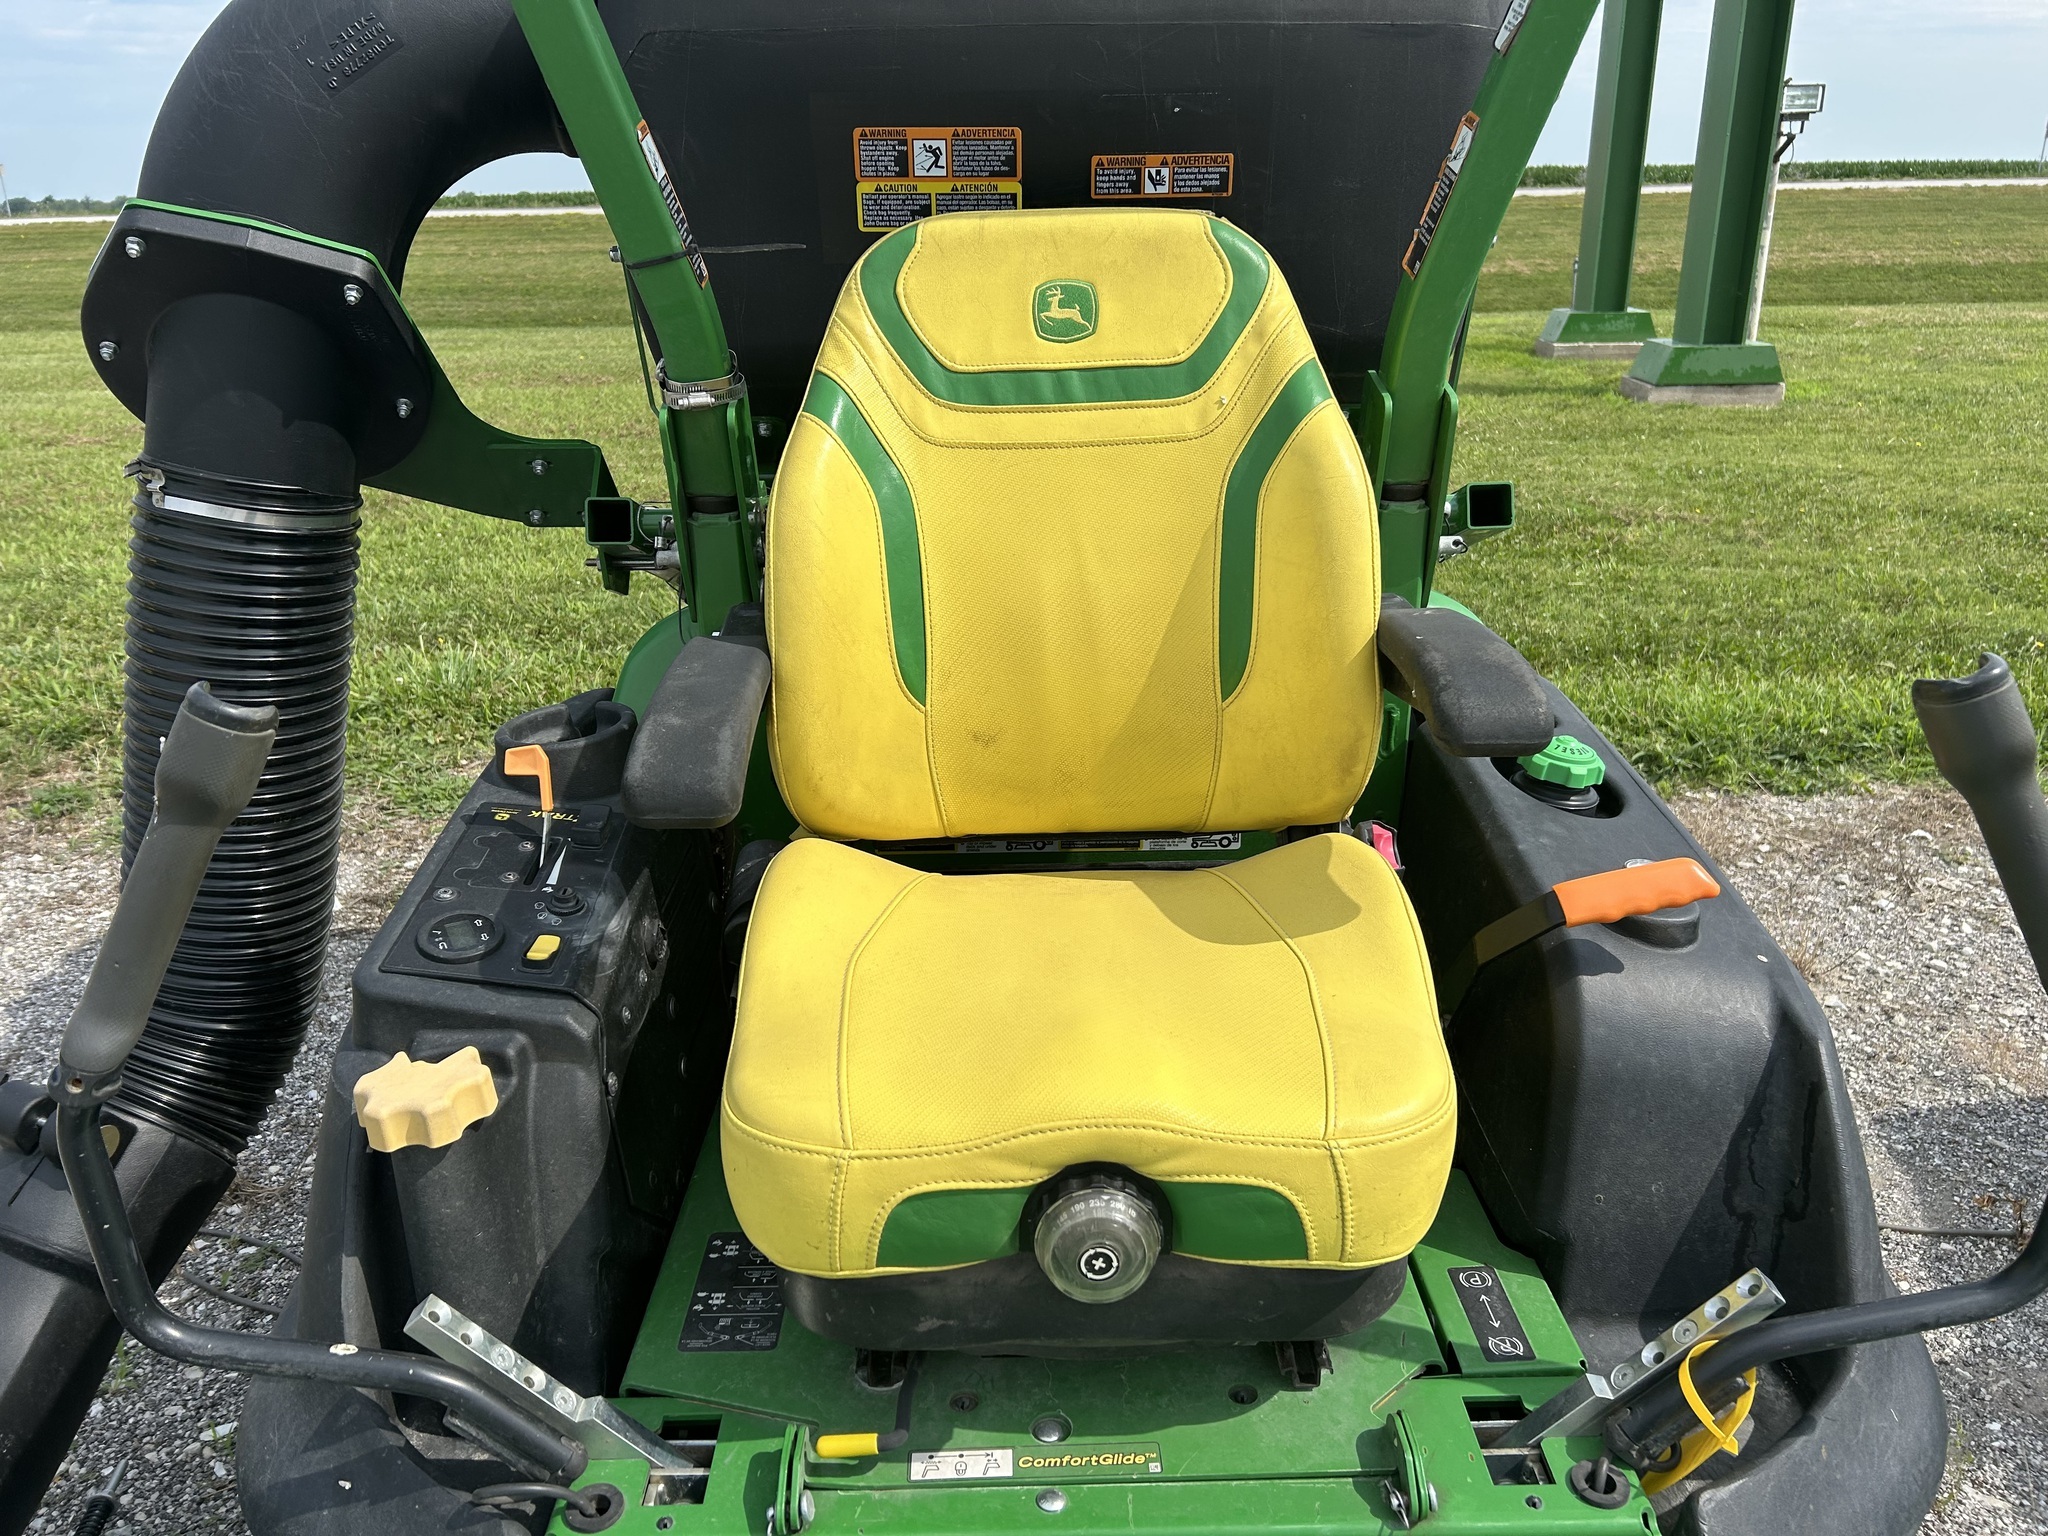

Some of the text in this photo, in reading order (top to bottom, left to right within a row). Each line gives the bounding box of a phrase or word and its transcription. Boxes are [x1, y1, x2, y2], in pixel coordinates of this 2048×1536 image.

[321, 21, 385, 73] MADE IN USA
[869, 129, 907, 137] WARNING
[961, 129, 1015, 137] ADVERTENCIA
[1106, 157, 1146, 166] WARNING
[1171, 155, 1229, 165] ADVERTENCIA
[884, 184, 918, 192] CAUTION
[960, 182, 998, 192] ATENCIÓN
[1070, 1202, 1085, 1213] 190
[1089, 1198, 1105, 1207] 235
